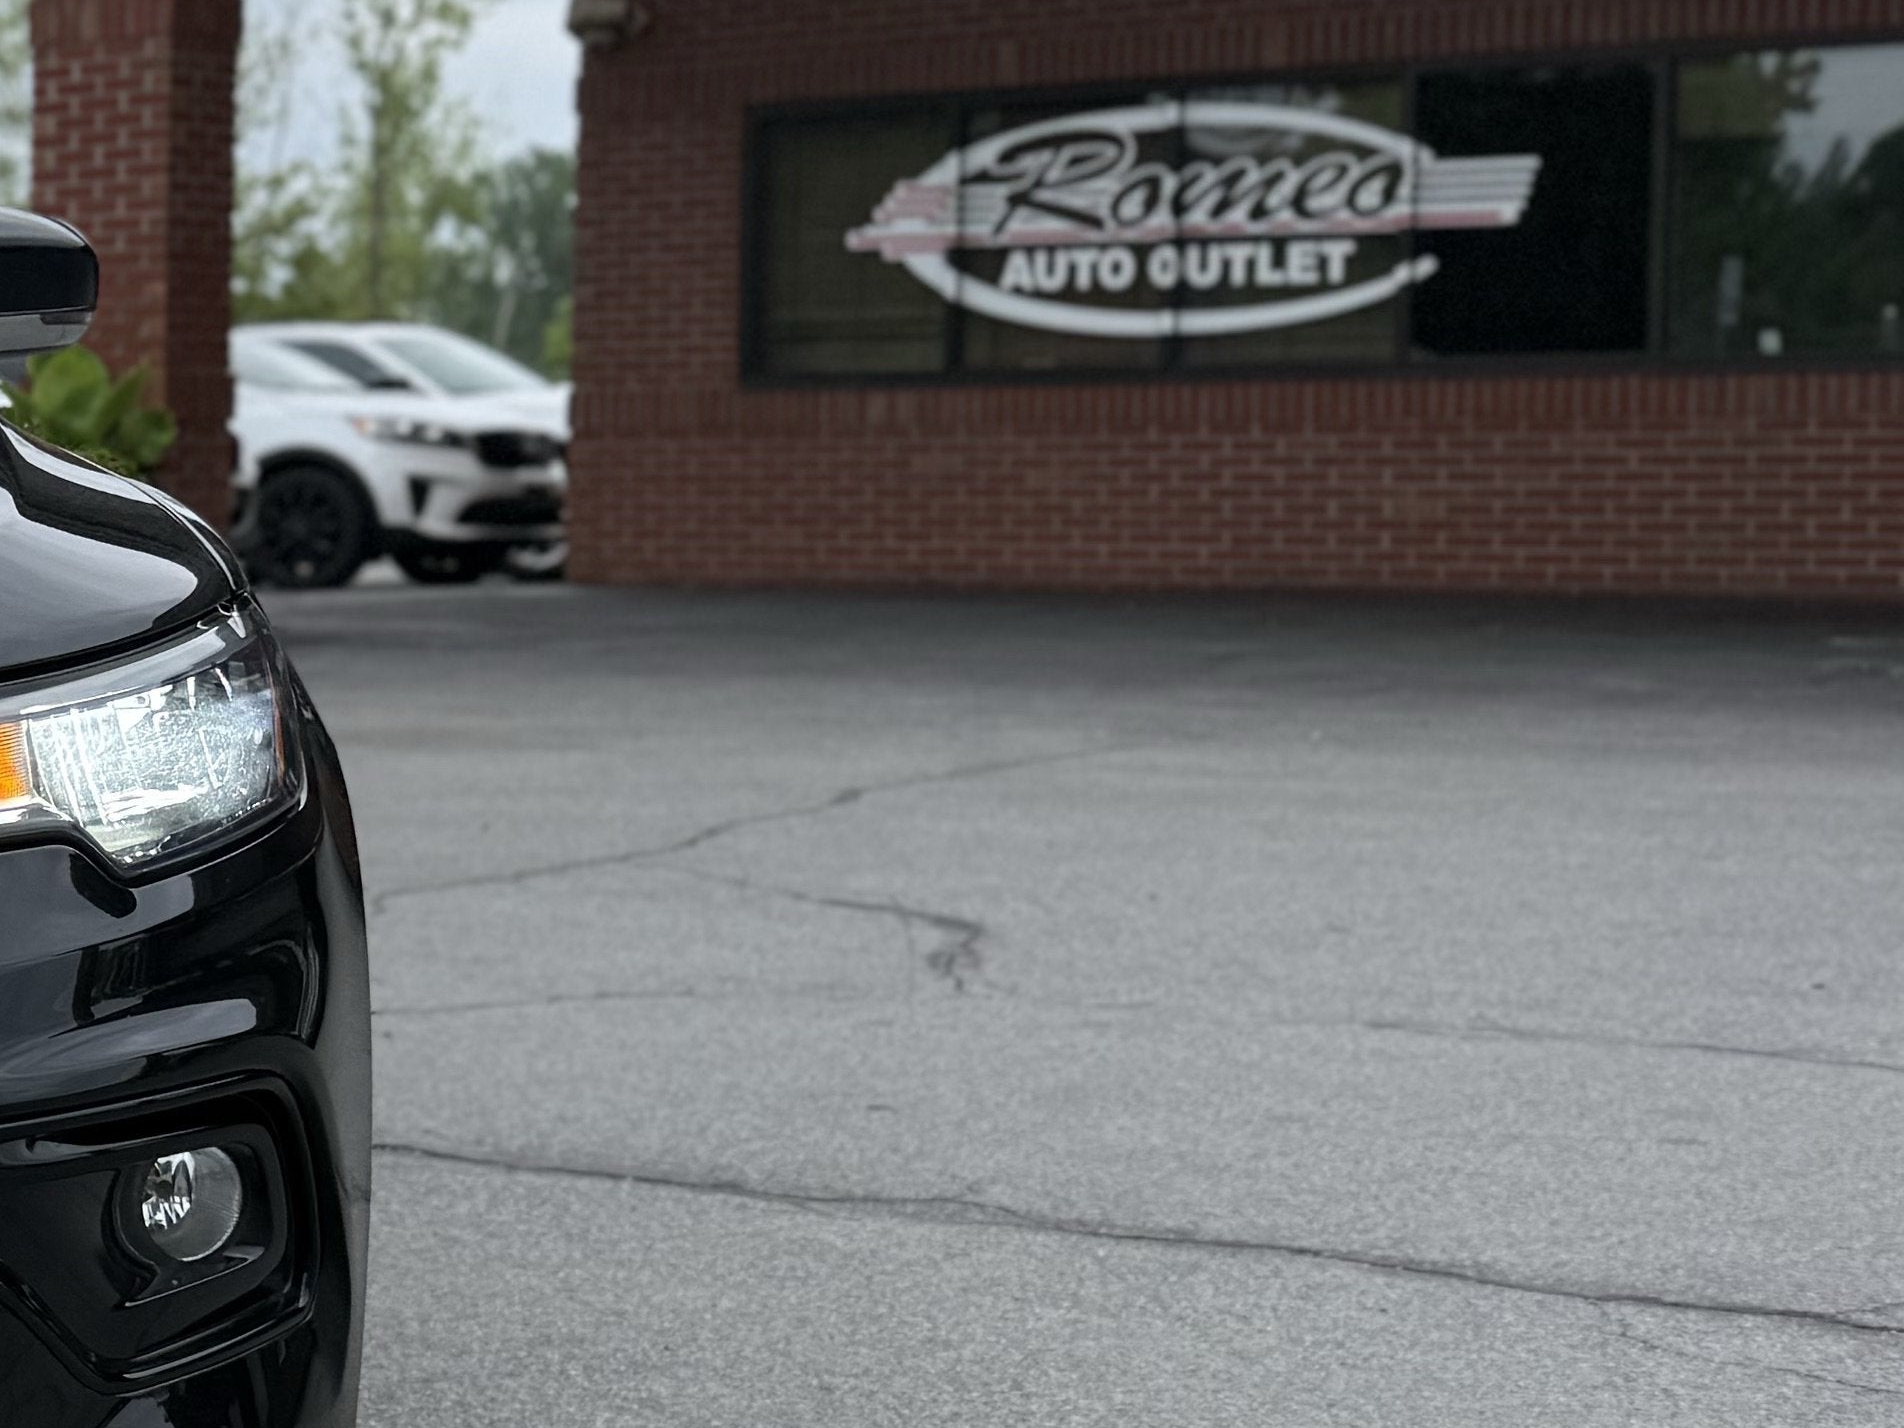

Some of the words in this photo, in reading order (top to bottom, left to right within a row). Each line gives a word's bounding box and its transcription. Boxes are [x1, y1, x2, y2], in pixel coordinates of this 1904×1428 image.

[995, 131, 1405, 236] Romeo
[998, 248, 1136, 293] AUTO
[1147, 240, 1357, 289] OUTLET
